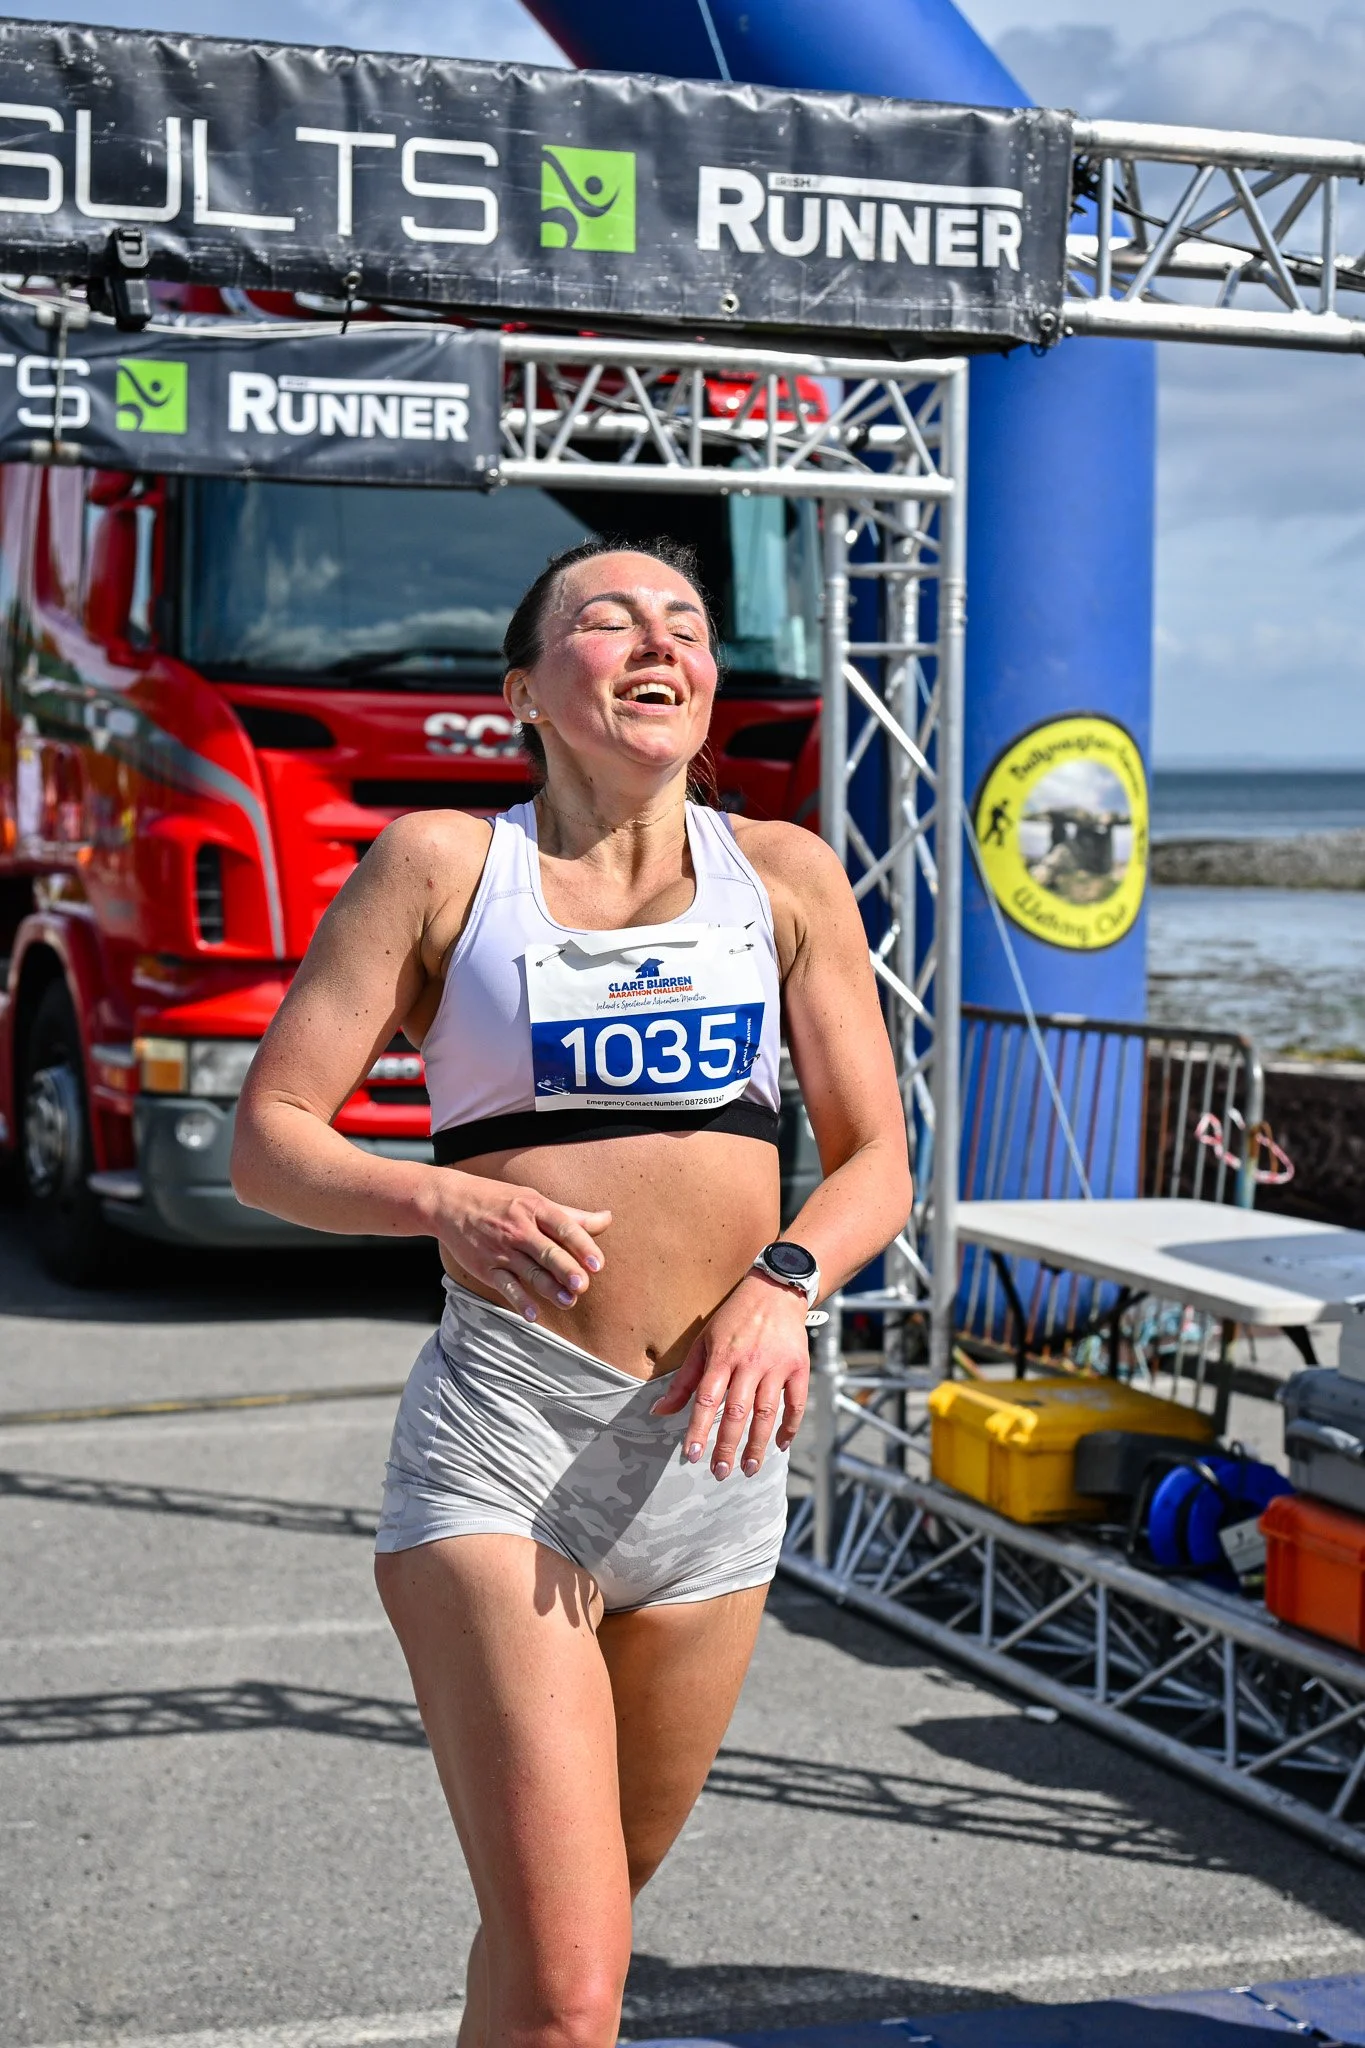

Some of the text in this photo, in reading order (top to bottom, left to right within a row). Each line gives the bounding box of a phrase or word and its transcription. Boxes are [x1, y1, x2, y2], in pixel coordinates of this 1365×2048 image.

[697, 165, 1023, 272] RUNNER
[228, 371, 470, 443] RUNNER
[608, 976, 692, 993] CLARE BURREN
[608, 985, 694, 999] MARATHON CHALLENGE
[560, 1012, 737, 1087] 1035
[586, 1099, 625, 1107] Emergency
